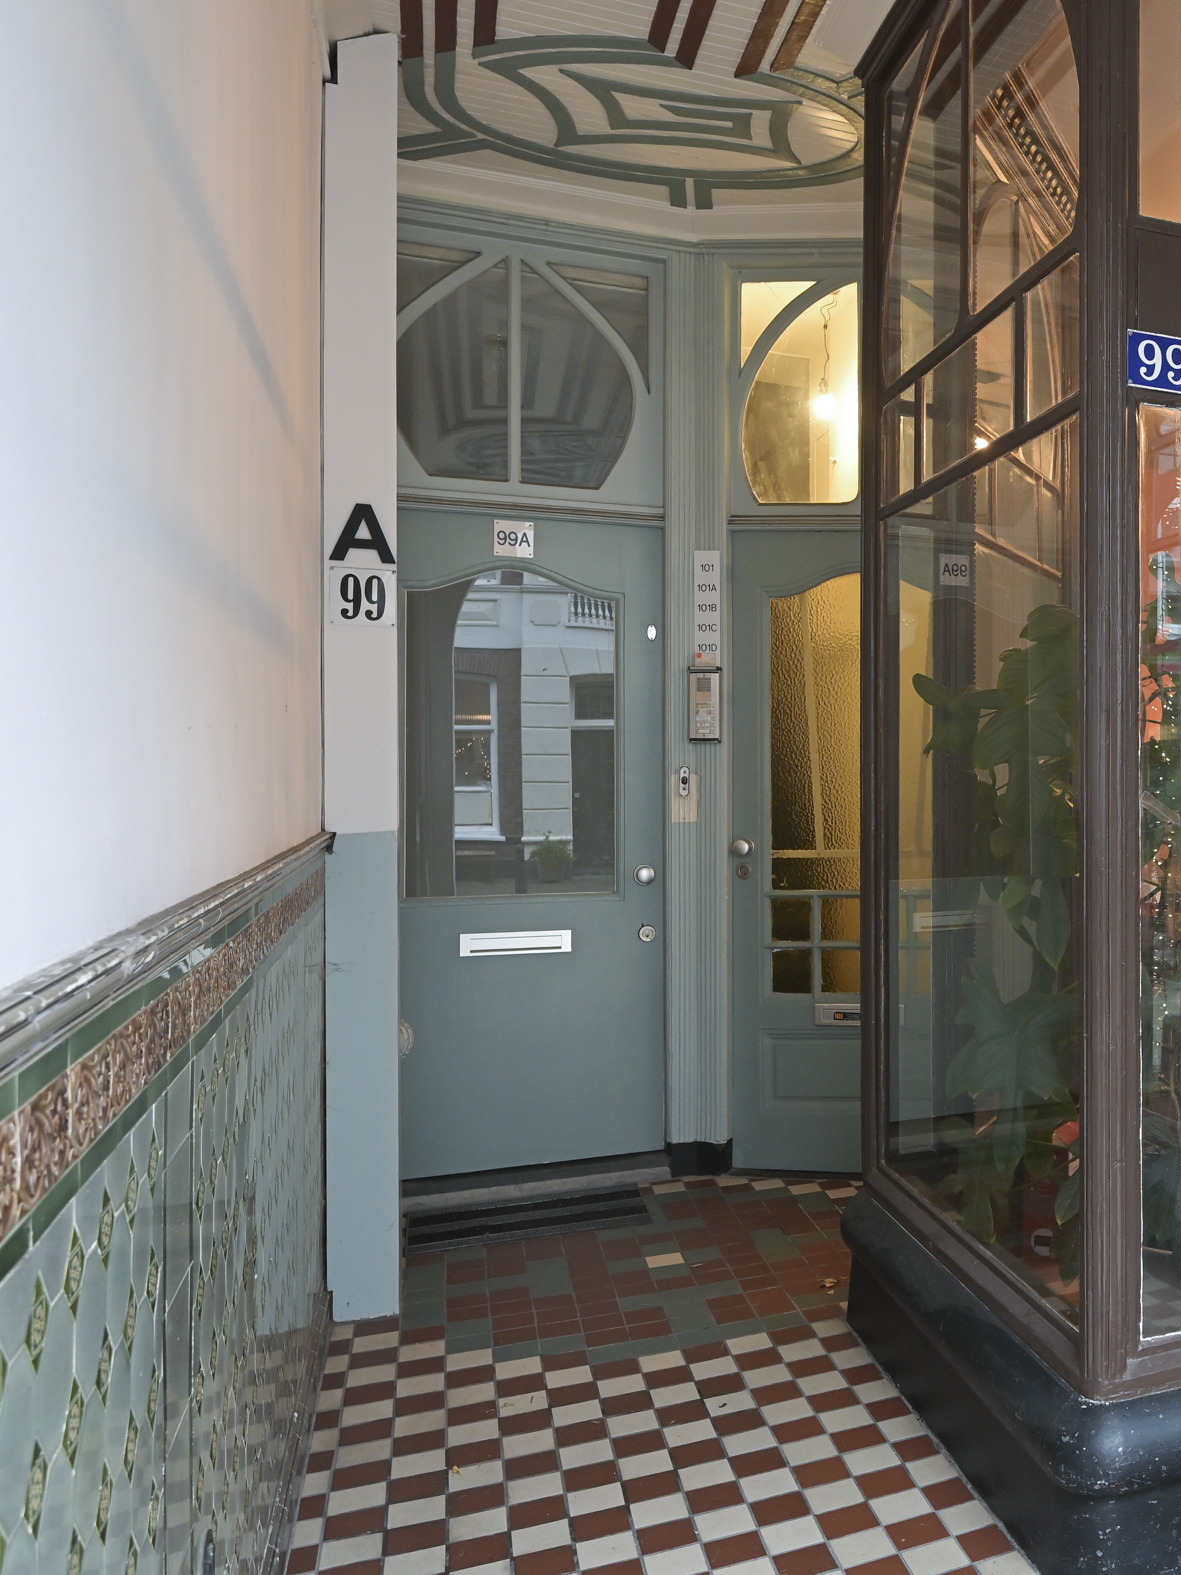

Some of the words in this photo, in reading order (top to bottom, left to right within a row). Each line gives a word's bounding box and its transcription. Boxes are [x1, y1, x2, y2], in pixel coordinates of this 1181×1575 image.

[329, 503, 396, 565] A
[496, 530, 530, 549] 99A
[700, 563, 714, 572] 101
[697, 584, 717, 592] 101A
[340, 572, 386, 622] 99
[697, 604, 717, 612] 101B
[697, 624, 718, 632] 101C
[697, 644, 718, 652] 101D
